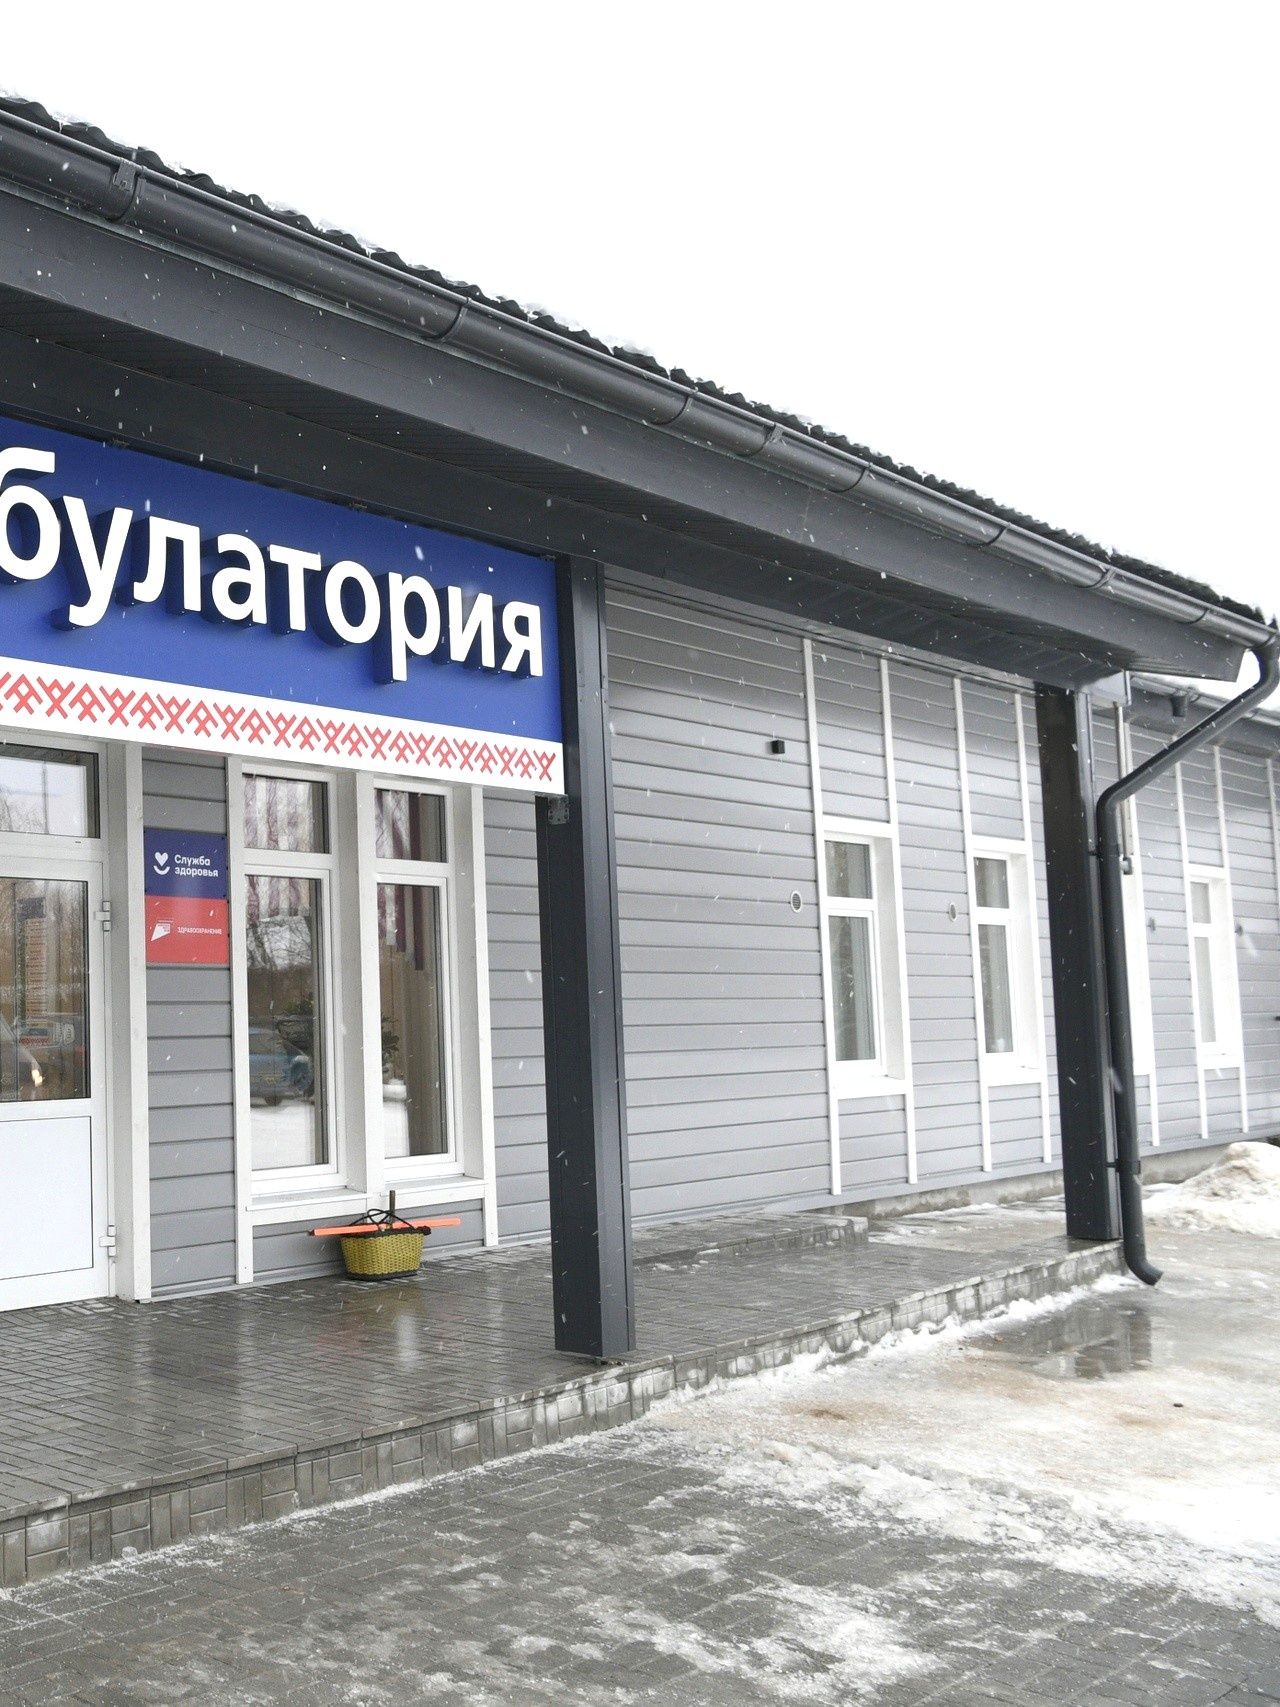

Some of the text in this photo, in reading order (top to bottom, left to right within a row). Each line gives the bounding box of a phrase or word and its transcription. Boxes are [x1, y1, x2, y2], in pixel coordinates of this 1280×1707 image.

[174, 854, 218, 877] Служба здоровья
[178, 927, 222, 935] ЗДРАВООХРАНЕНИЕ
